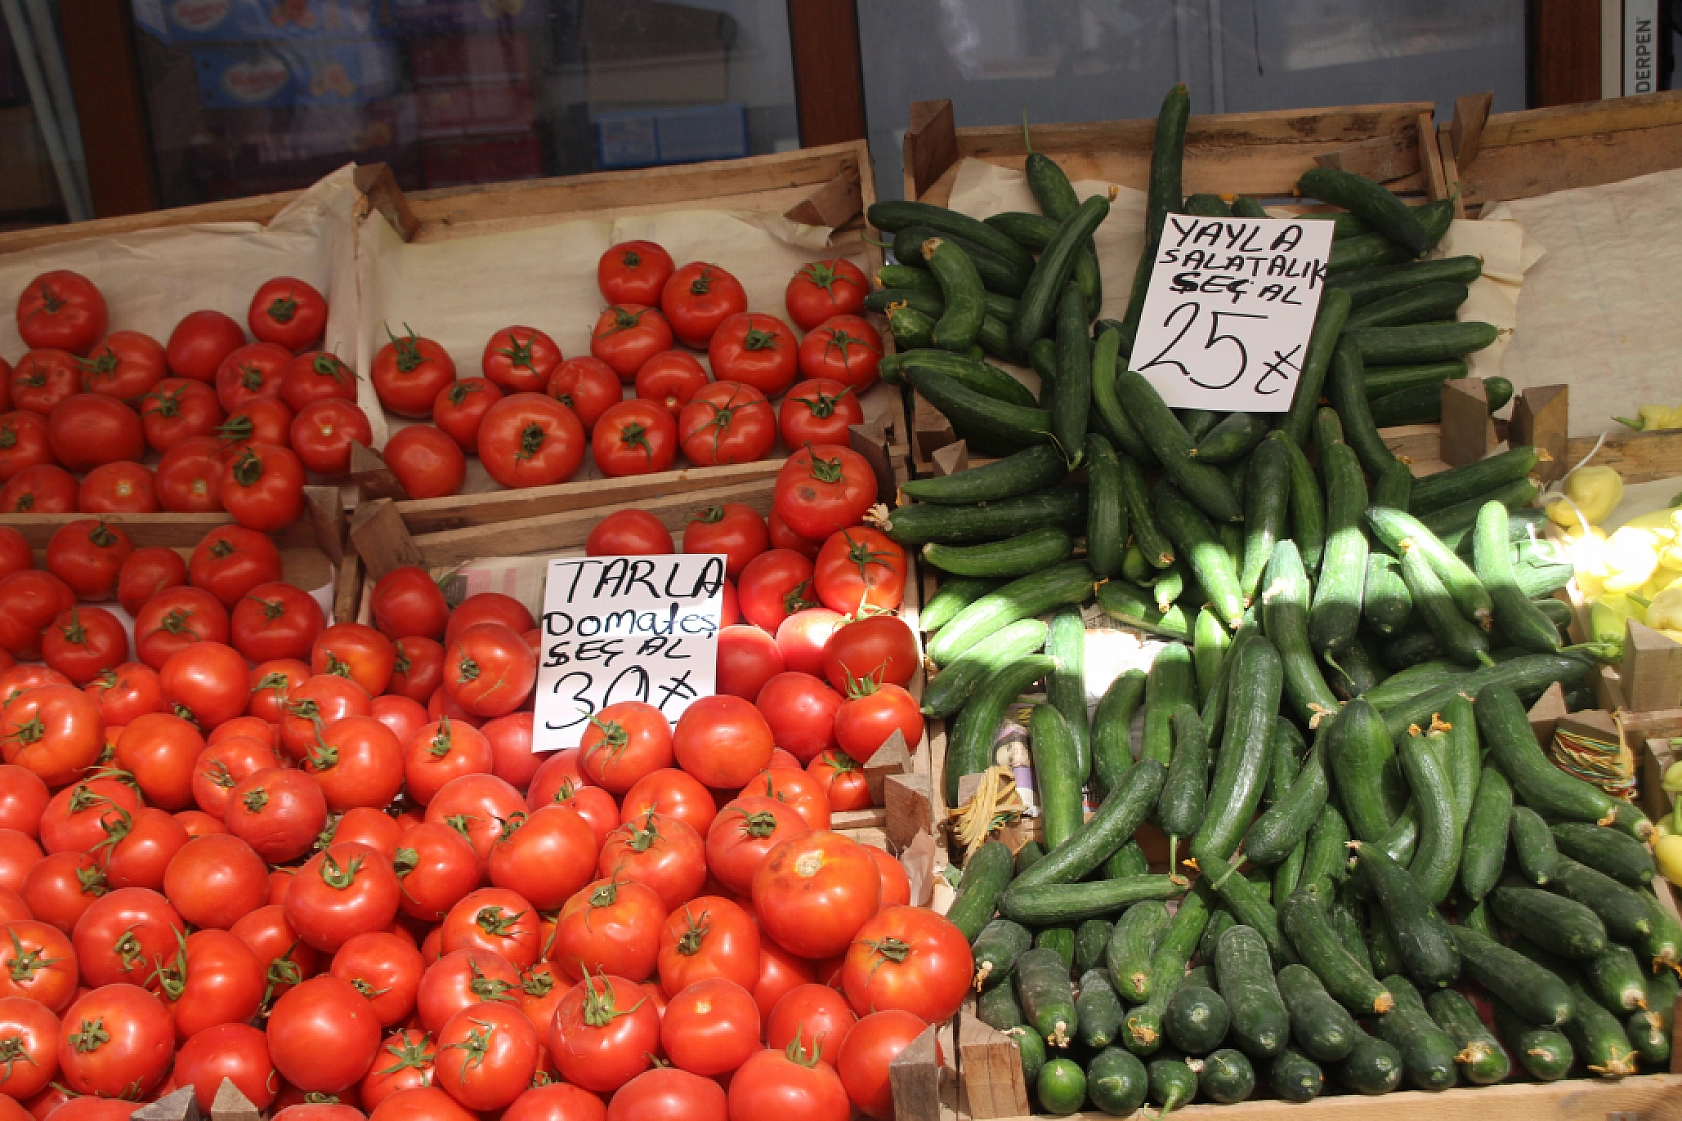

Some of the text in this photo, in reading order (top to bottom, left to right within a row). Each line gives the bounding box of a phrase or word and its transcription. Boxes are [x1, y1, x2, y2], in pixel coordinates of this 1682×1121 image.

[1171, 217, 1303, 252] YAYLA
[1159, 249, 1327, 289] SALATALIK
[1257, 284, 1302, 305] AL
[555, 557, 724, 603] TARLA
[636, 636, 692, 659] AL
